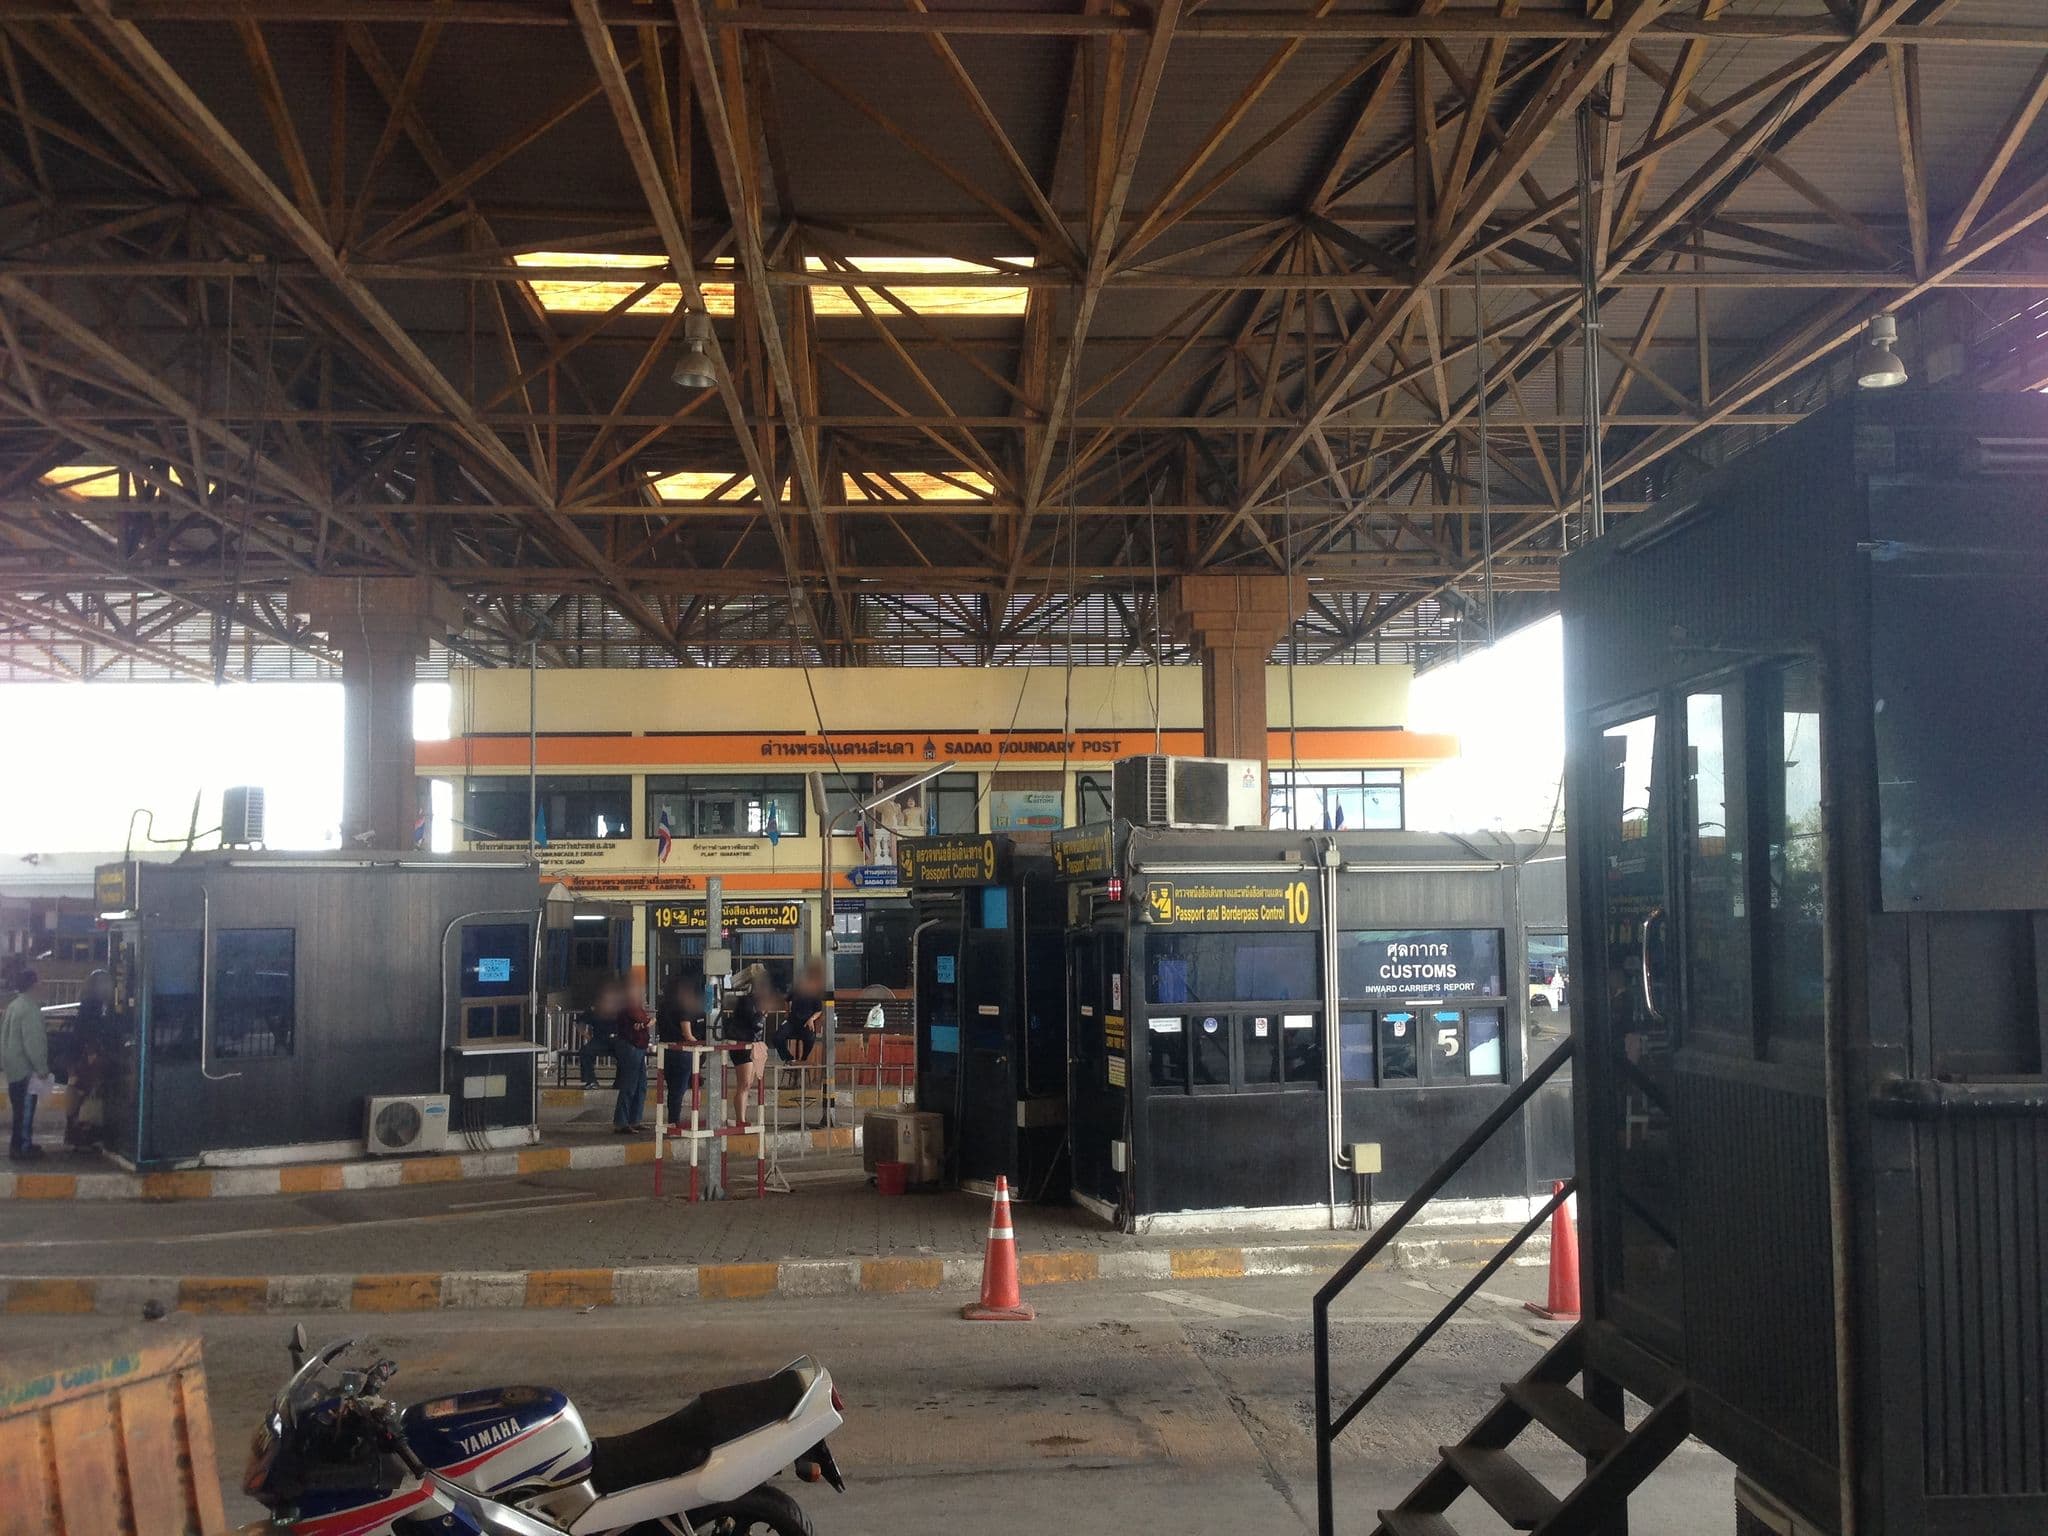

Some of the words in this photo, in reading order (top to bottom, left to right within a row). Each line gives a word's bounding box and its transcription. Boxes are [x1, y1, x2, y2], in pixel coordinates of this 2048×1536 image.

[761, 738, 914, 755] ด่านพรมแดนสะเดา
[944, 741, 992, 754] SADAO
[1000, 740, 1075, 754] BOUNDARY
[1082, 740, 1122, 753] POST
[983, 839, 995, 880] 9
[921, 865, 952, 883] Passport
[952, 863, 979, 880] Control
[1285, 881, 1309, 925] 10
[656, 907, 671, 927] 19
[743, 916, 782, 925] Control
[782, 905, 798, 925] 20
[1175, 905, 1204, 924] Passport
[1207, 906, 1219, 920] and
[1221, 905, 1258, 924] Borderpass
[1260, 904, 1285, 920] Control
[1387, 943, 1448, 963] ศุลกากร
[1380, 964, 1457, 979] CUSTOMS
[1365, 985, 1397, 993] INWARD
[1399, 984, 1440, 993] CARRIER'S
[1444, 983, 1475, 991] REPORT
[1438, 1028, 1459, 1057] 5
[460, 1417, 521, 1455] YAMAHA
